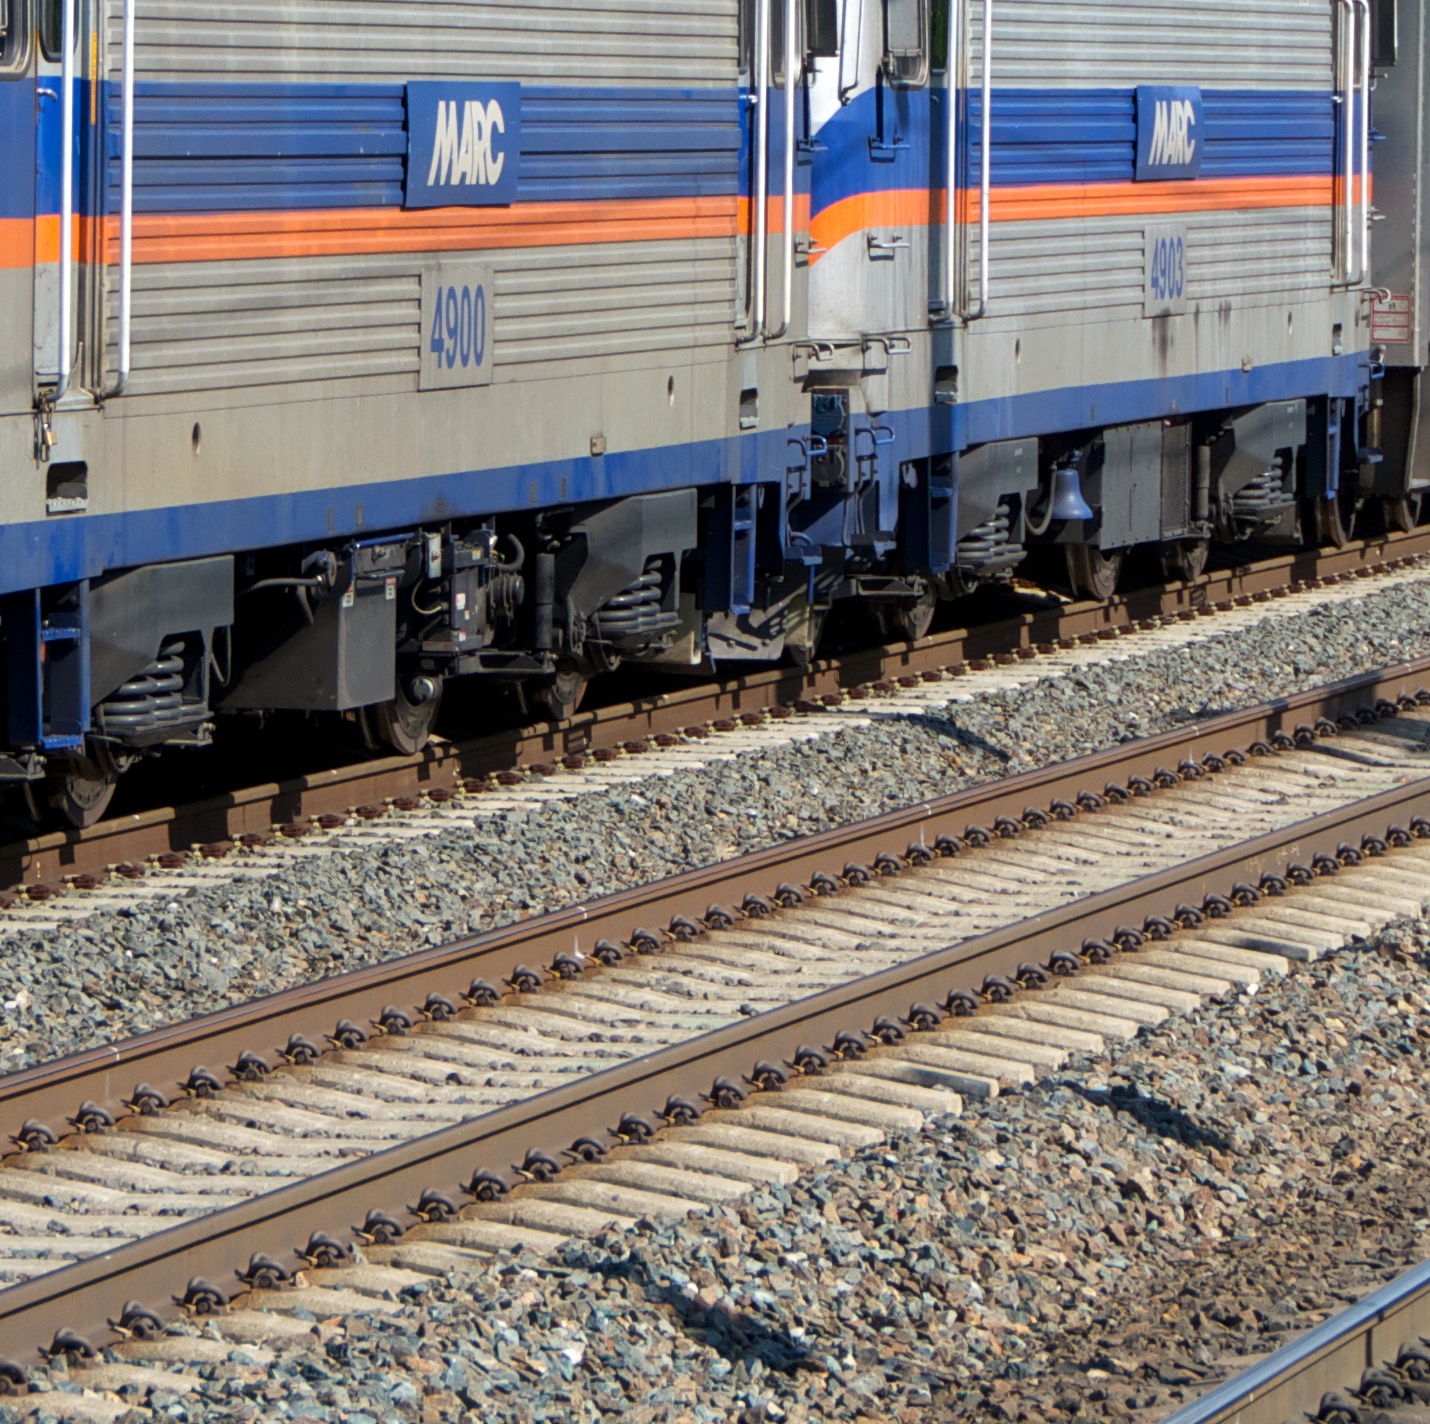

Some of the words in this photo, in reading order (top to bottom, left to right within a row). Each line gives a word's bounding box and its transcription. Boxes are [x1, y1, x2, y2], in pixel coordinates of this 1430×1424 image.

[426, 98, 506, 187] MARC
[1147, 98, 1196, 166] MARC
[1150, 236, 1184, 301] 4903
[430, 284, 486, 370] 4900
